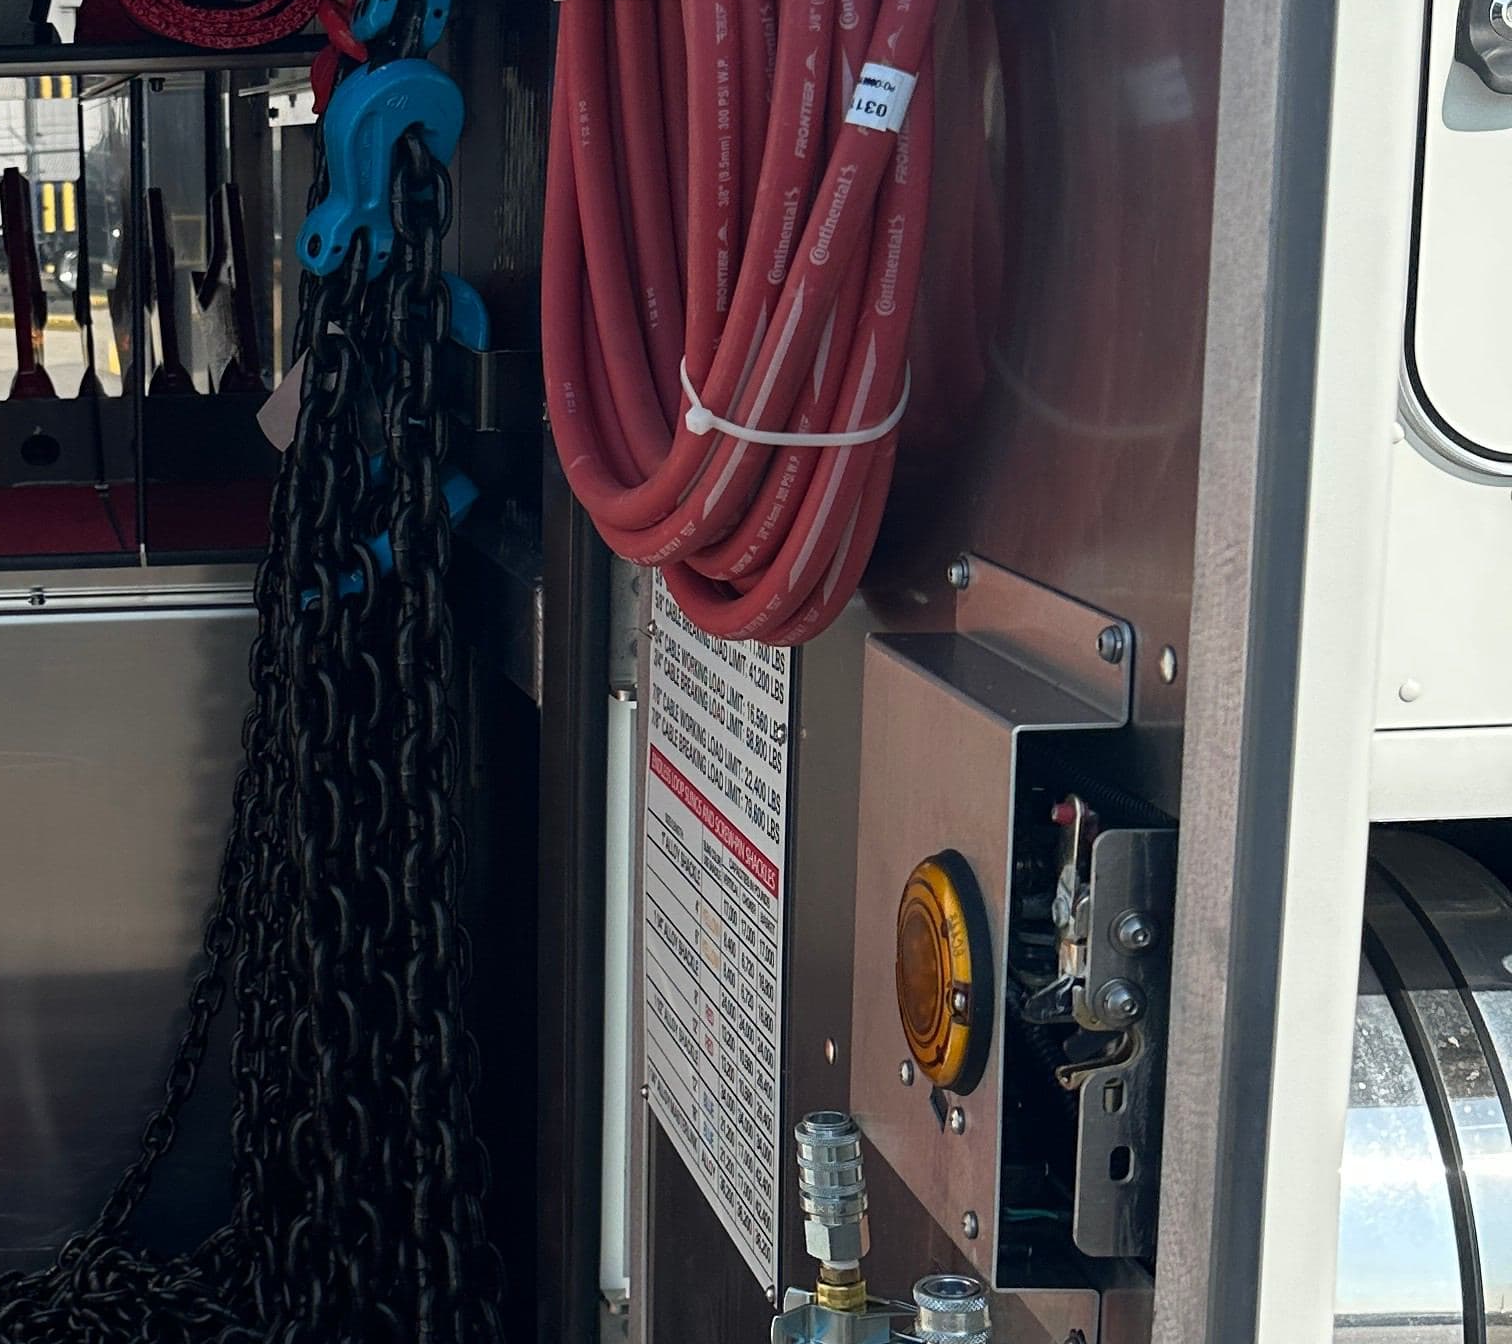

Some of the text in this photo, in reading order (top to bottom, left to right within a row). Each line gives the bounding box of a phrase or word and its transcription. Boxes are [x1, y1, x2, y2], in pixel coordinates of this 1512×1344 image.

[717, 87, 730, 106] PSI
[794, 80, 815, 158] FRONTIER
[809, 7, 822, 32] 3/8"
[853, 99, 888, 117] 031
[717, 110, 730, 130] 300
[718, 136, 732, 182] (9.5mm)
[717, 185, 730, 208] 3/8"
[809, 177, 852, 266] Continental
[767, 199, 799, 286] Continental
[715, 248, 730, 313] FRONTIER
[874, 225, 904, 316] Continental
[665, 596, 681, 627] CABLE
[682, 616, 710, 650] BREAKING
[711, 635, 727, 662] LOAD
[748, 659, 769, 696] 41,200
[770, 675, 784, 706] LBS
[771, 645, 785, 676] LBS
[663, 656, 680, 687] CABLE
[680, 671, 708, 712] BREAKING
[709, 694, 725, 726] LOAD
[745, 725, 767, 765] 58,800
[768, 744, 782, 775] LBS
[664, 633, 680, 663] CABLE
[681, 647, 707, 686] WORKING
[708, 669, 725, 701] LOAD
[747, 700, 768, 737] 16,560
[769, 717, 783, 748] LB
[661, 716, 678, 750] CABLE
[678, 732, 706, 777] BREAKING
[707, 759, 723, 793] LOAD
[743, 793, 765, 836] 79,600
[766, 814, 779, 847] LBS
[662, 691, 679, 723] CABLE
[680, 707, 706, 749] WORKING
[707, 732, 723, 765] LOAD
[744, 765, 766, 806] 22,400
[767, 785, 781, 818] LBS
[651, 750, 776, 893] ENDLESS LOOP SLINGS AND SCREW-PIN SHACKLES
[665, 834, 679, 865] ALLOY
[680, 850, 700, 888] SHACKLE
[723, 896, 737, 929] 17,000
[741, 916, 755, 949] 17,000
[664, 921, 677, 951] ALLOY
[678, 939, 698, 977] SHACKLE
[759, 936, 774, 970] 17,000
[721, 991, 736, 1024] 24,000
[739, 1013, 754, 1047] 24,000
[664, 1006, 678, 1038] ALLOY
[678, 1025, 697, 1066] SHACKLE
[757, 1035, 773, 1071] 24,000
[701, 1147, 715, 1182] ALLOY
